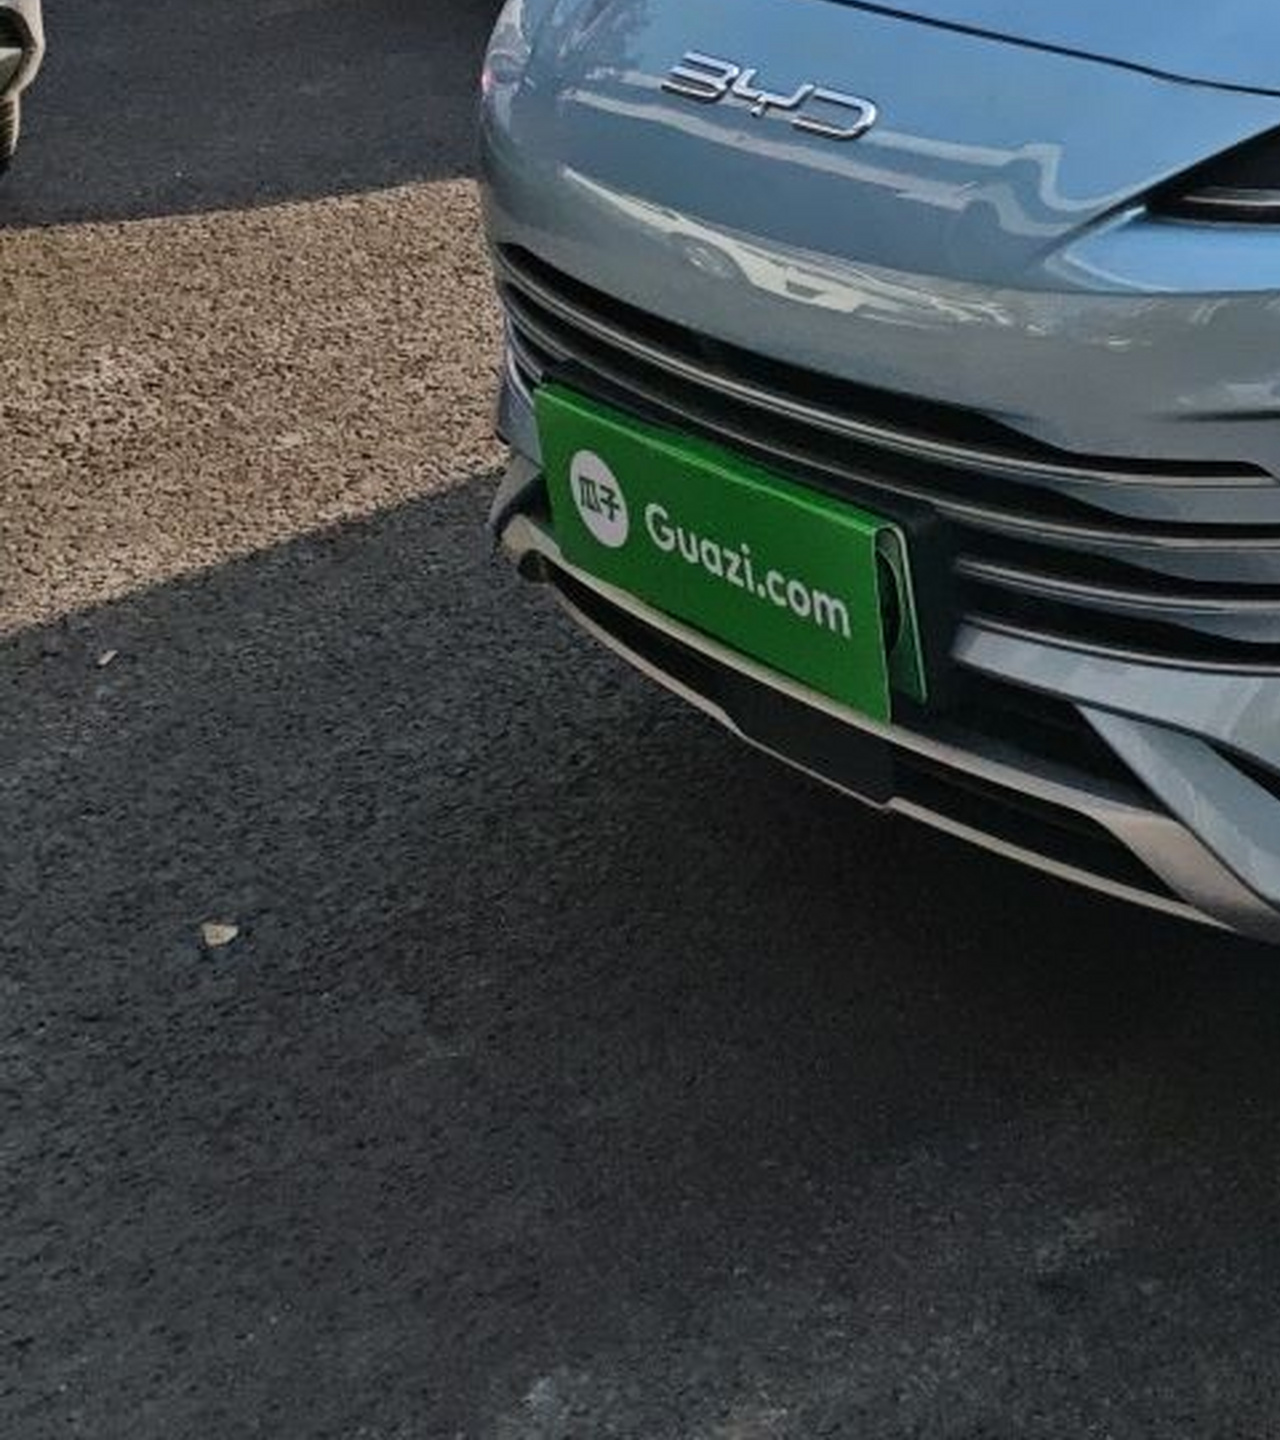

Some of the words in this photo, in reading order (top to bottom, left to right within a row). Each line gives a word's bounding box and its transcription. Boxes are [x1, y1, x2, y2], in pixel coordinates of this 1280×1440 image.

[660, 51, 877, 142] BYD
[579, 476, 620, 522] 瓜子
[645, 503, 852, 640] Guazi.com
